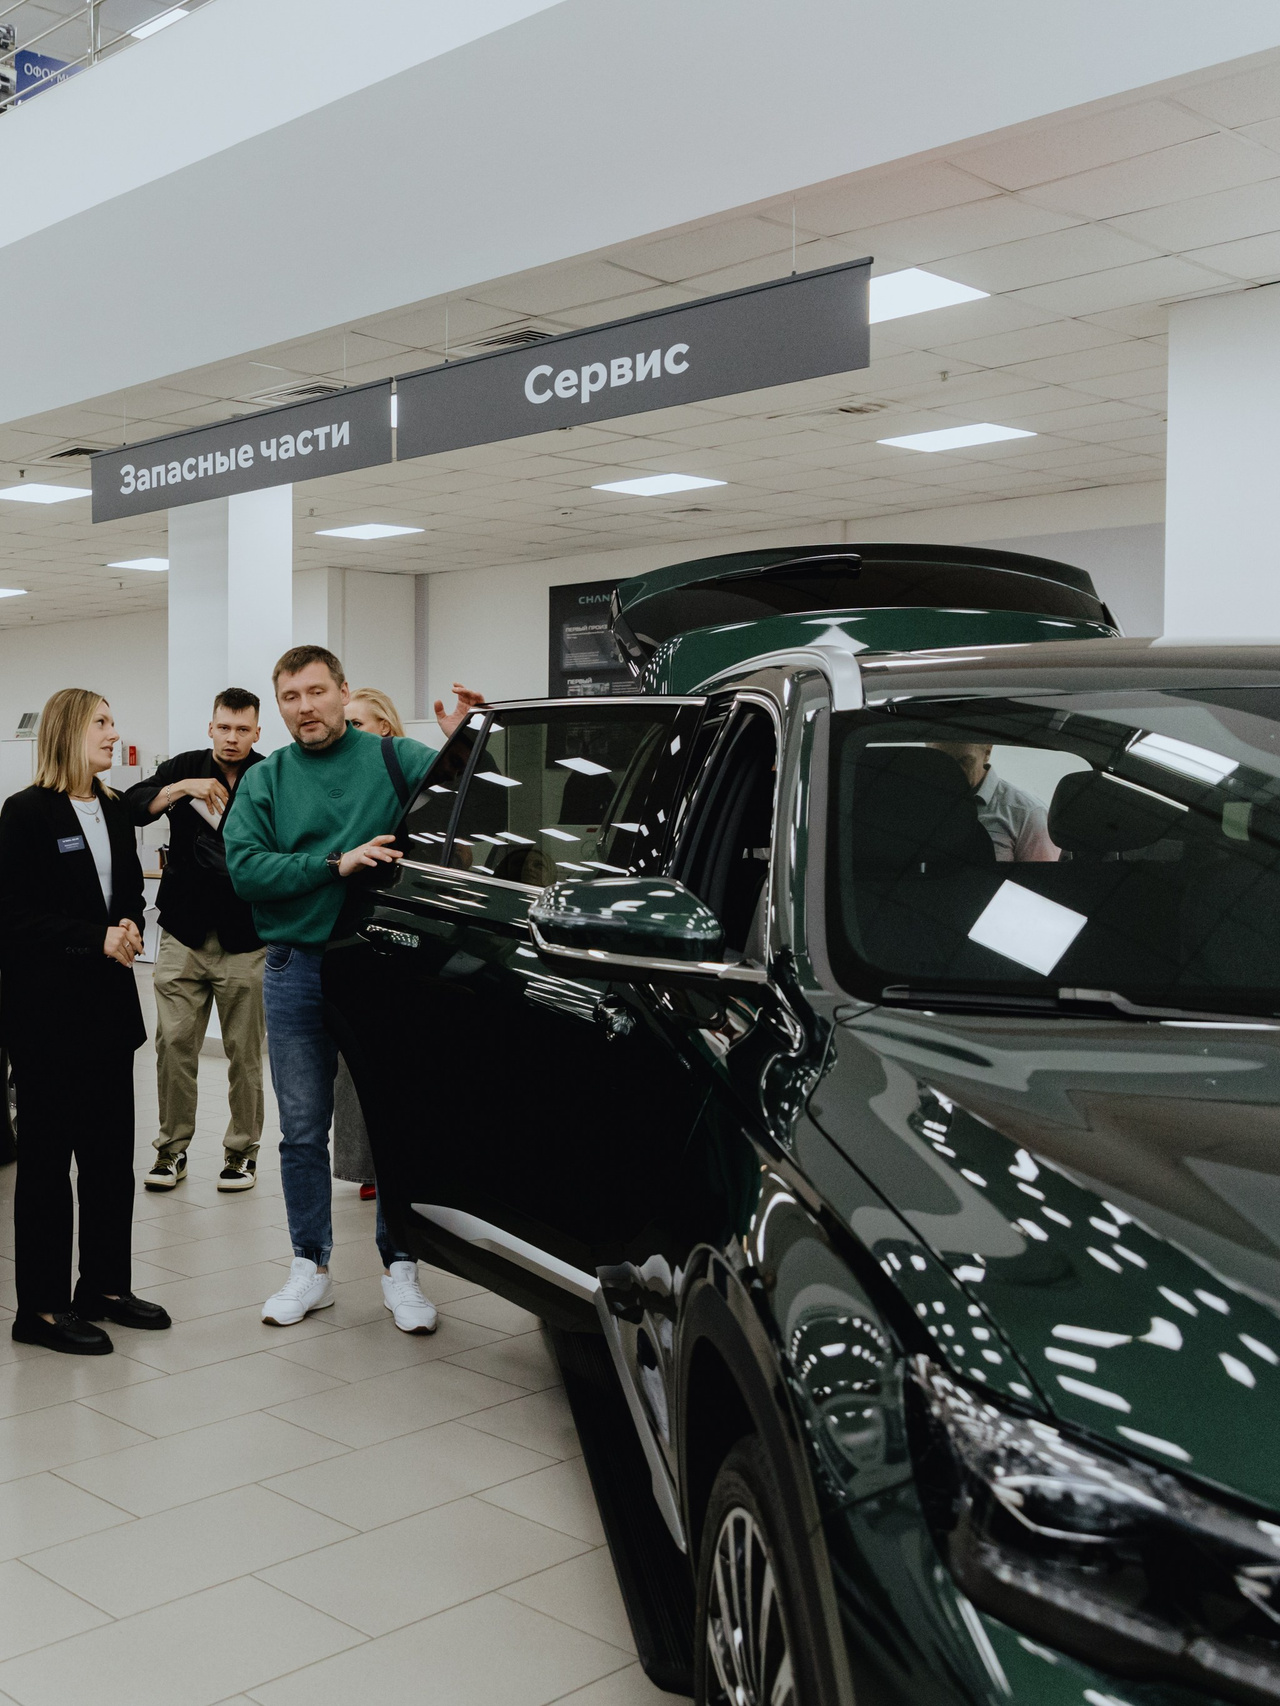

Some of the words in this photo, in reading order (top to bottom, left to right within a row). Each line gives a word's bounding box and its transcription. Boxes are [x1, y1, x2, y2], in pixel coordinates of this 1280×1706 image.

[524, 343, 690, 404] Сервис
[120, 444, 254, 495] Запасные
[260, 421, 350, 462] части
